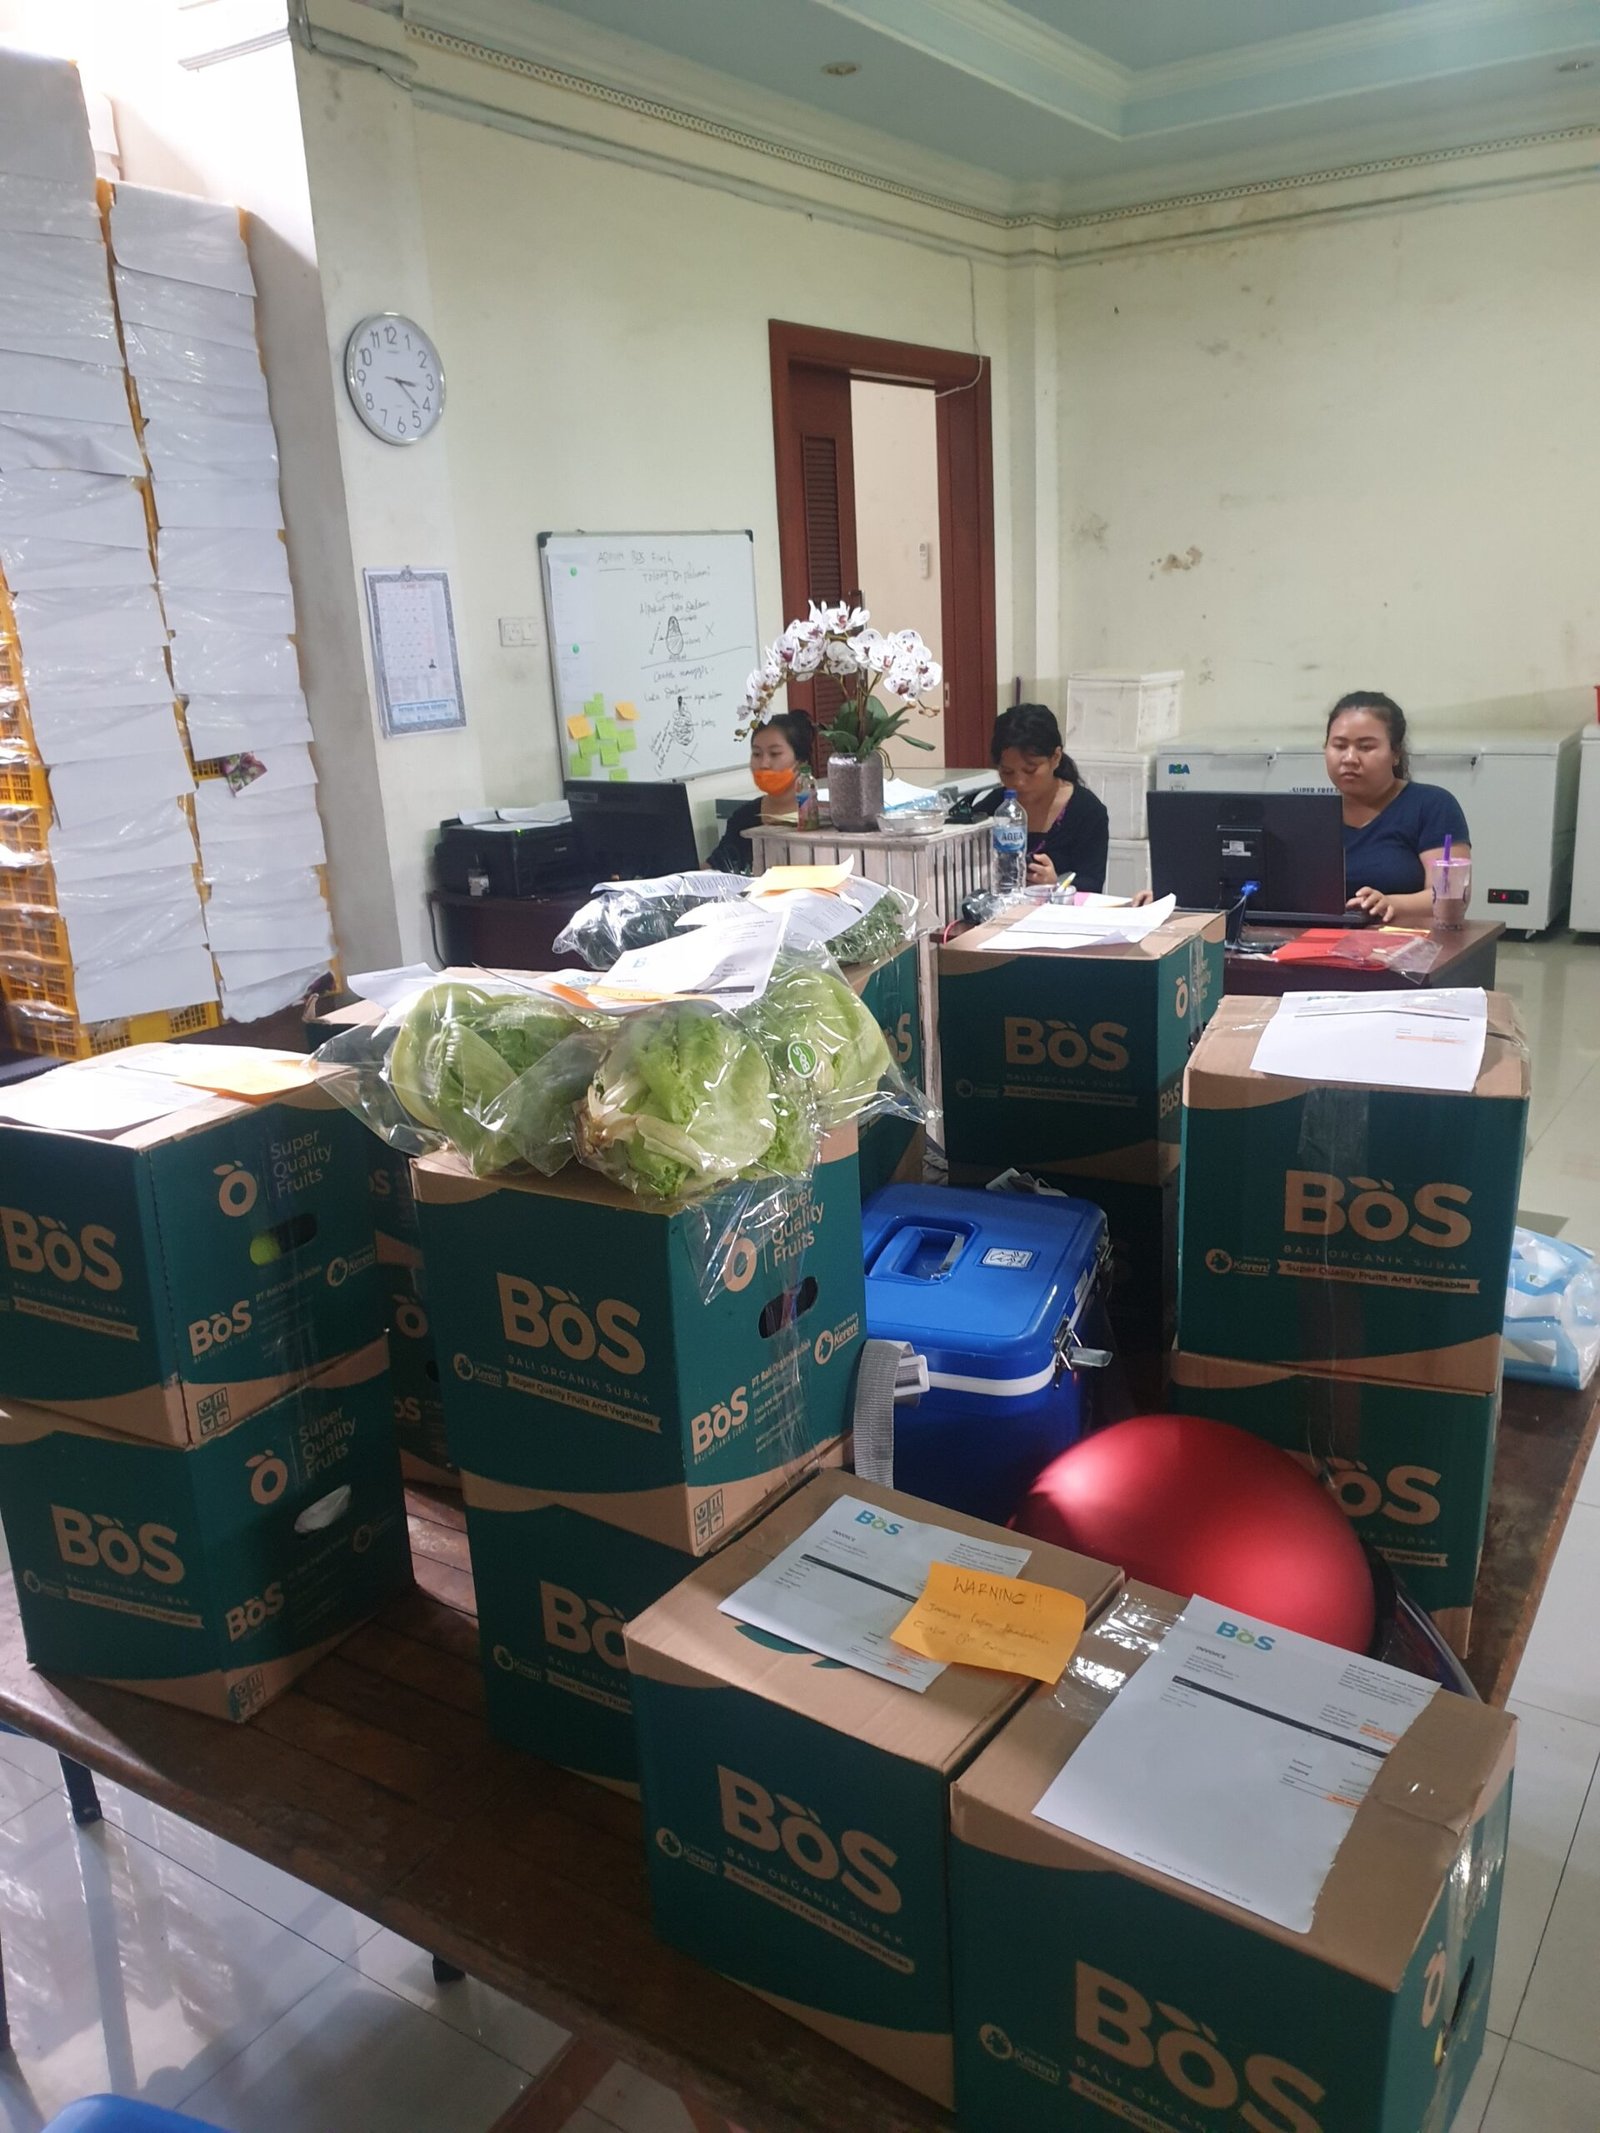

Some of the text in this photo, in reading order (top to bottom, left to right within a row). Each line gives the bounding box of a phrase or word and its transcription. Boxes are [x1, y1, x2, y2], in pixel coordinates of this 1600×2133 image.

[370, 330, 380, 348] 11
[384, 325, 397, 345] 12
[405, 334, 411, 350] 1
[359, 348, 372, 366] 10
[417, 350, 427, 368] 2
[357, 370, 366, 387] 9
[426, 374, 434, 392] 3
[365, 393, 374, 410] 8
[423, 397, 431, 413] 4
[380, 409, 388, 426] 7
[397, 417, 406, 433] 6
[412, 411, 422, 428] 5
[1168, 764, 1190, 775] RSA
[1001, 831, 1024, 843] AQUA
[270, 1129, 320, 1161] Super
[273, 1144, 332, 1180] Quality
[276, 1167, 323, 1199] Fruits
[771, 1202, 824, 1246] Quality
[774, 1230, 815, 1268] Fruits
[1286, 1263, 1471, 1291] Super Quality Fruits And Vegetables
[834, 1318, 859, 1347] Keren!
[541, 1364, 600, 1391] ORGANIK
[605, 1383, 650, 1405] SUBAK
[512, 1375, 655, 1427] Super Quality Fruits And Vegetables
[299, 1405, 343, 1443] Super
[303, 1416, 357, 1460] Quality
[306, 1442, 349, 1479] Fruits
[953, 1576, 1025, 1606] WARNING
